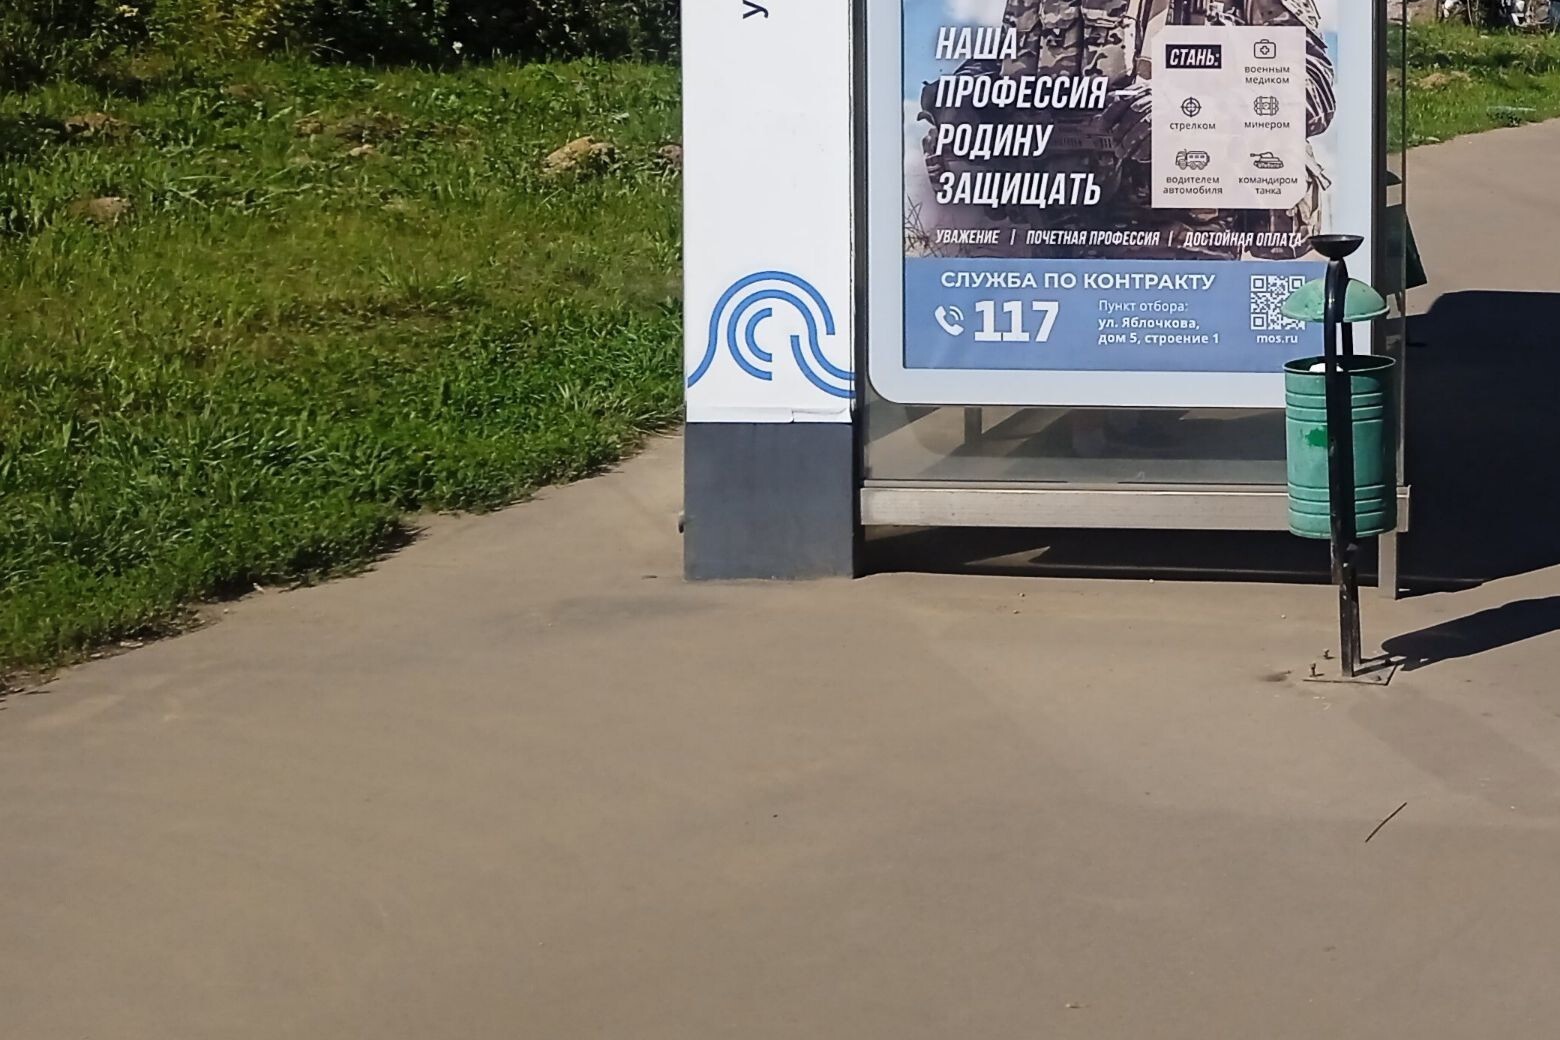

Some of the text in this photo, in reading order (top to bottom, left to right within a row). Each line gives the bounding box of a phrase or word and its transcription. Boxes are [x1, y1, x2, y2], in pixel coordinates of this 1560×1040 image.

[935, 26, 1018, 60] НАША
[1169, 48, 1220, 67] СТАНЬ:
[1244, 66, 1290, 74] военным
[1245, 77, 1290, 85] медиком
[935, 75, 1109, 109] ПРОФЕССИЯ
[1169, 122, 1216, 132] стрелком
[1244, 121, 1290, 131] минером
[935, 123, 1054, 160] РОДИНУ
[1166, 176, 1220, 185] водителем
[1238, 176, 1298, 185] командиром
[936, 171, 1101, 209] ЗАЩИЩАТЬ
[1162, 185, 1223, 195] автомобиля
[1255, 186, 1282, 195] танка
[935, 229, 1001, 245] УВАЖЕНИЕ
[1026, 229, 1160, 247] ПОЧЕТНАЯ ПРОФЕССИЯ
[1183, 230, 1302, 248] ДОСТОЙНАЯ ОПЛАТА
[940, 271, 1216, 290] СЛУЖБА ПО КОНТРАКТУ
[1098, 300, 1189, 314] Пункт отбора:
[974, 300, 1060, 343] 117
[1098, 317, 1200, 331] ул. Яблочкова,
[1098, 333, 1220, 346] дом 5, строение 1
[1256, 334, 1299, 344] mos.ru
